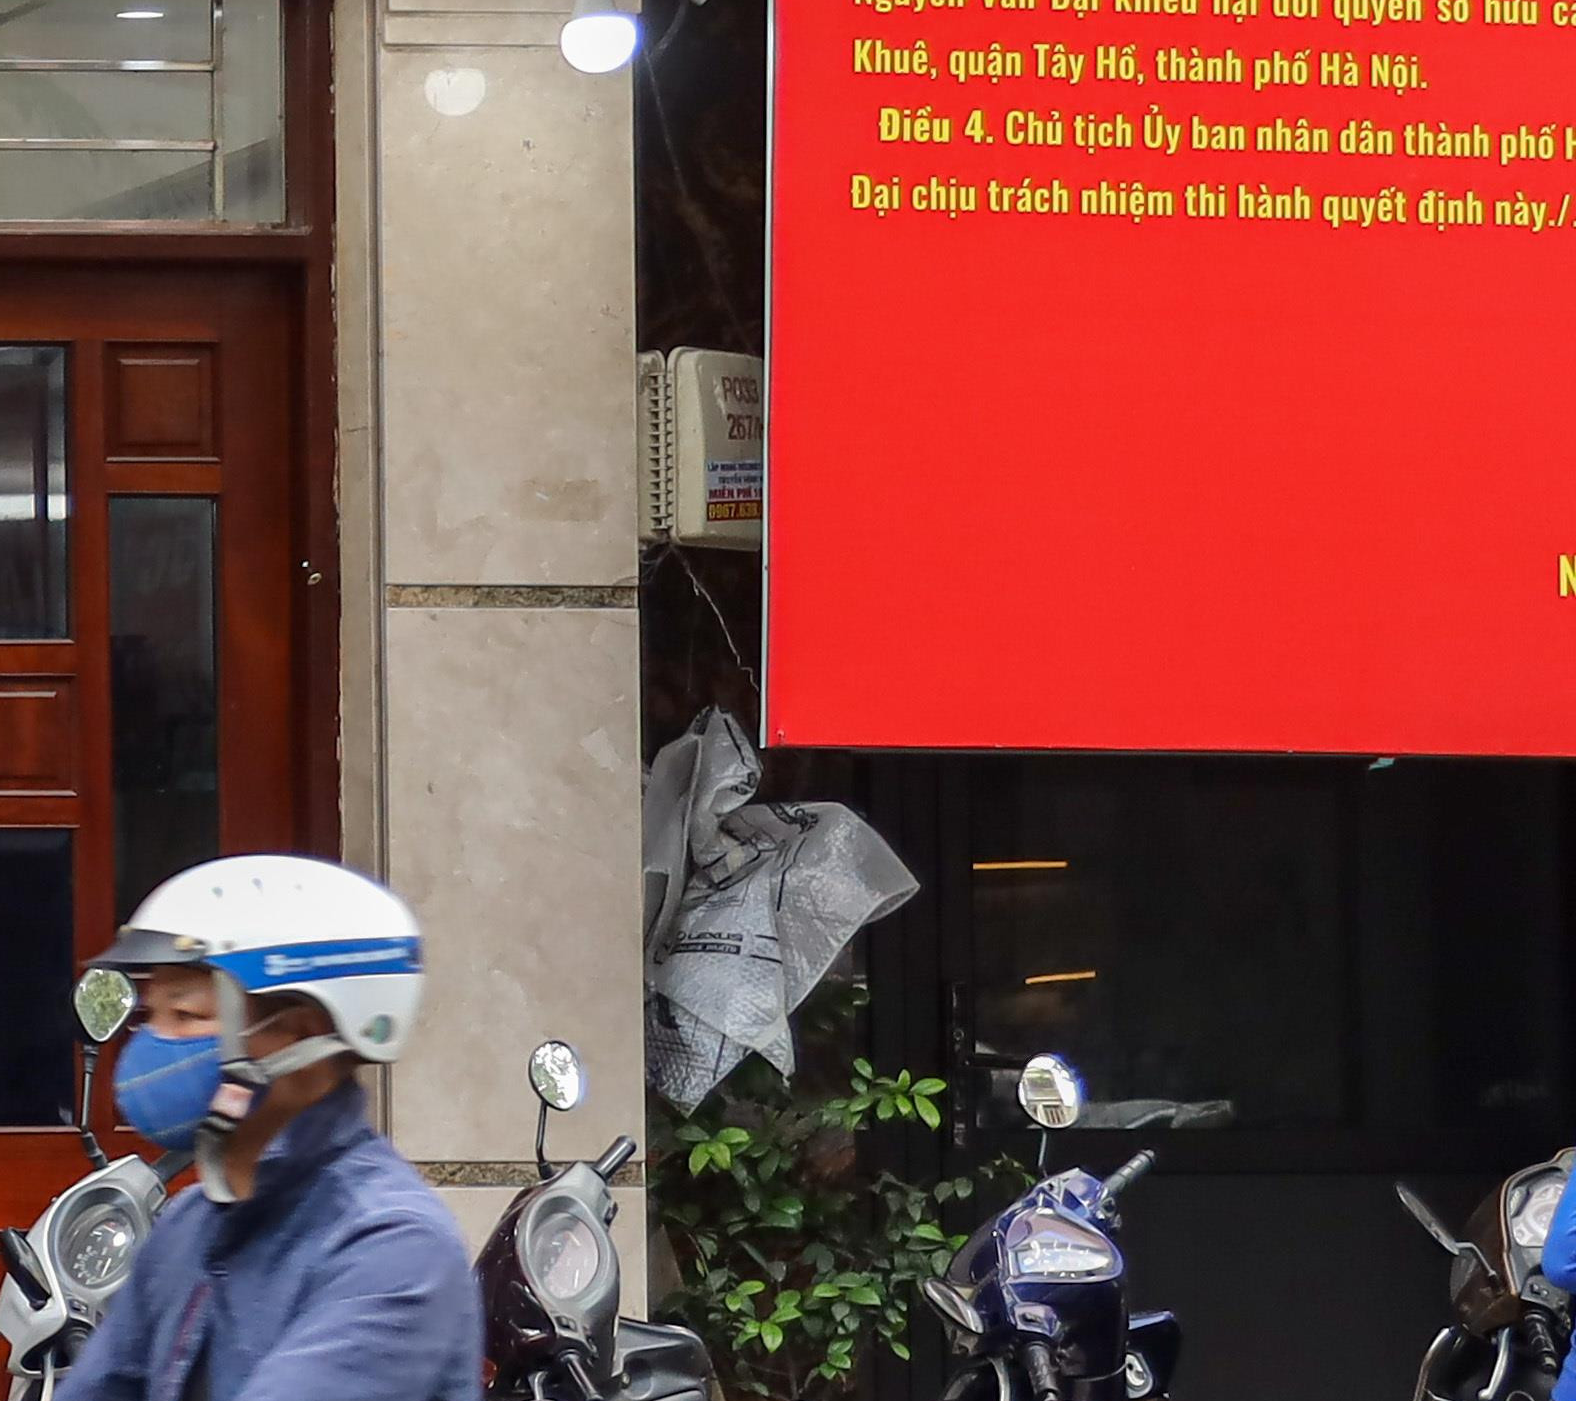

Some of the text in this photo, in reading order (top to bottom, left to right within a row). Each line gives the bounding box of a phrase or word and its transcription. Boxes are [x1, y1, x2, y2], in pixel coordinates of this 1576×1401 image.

[853, 38, 1429, 97] Khuê, quận Tây Hồ, thành phố Hà Nội.
